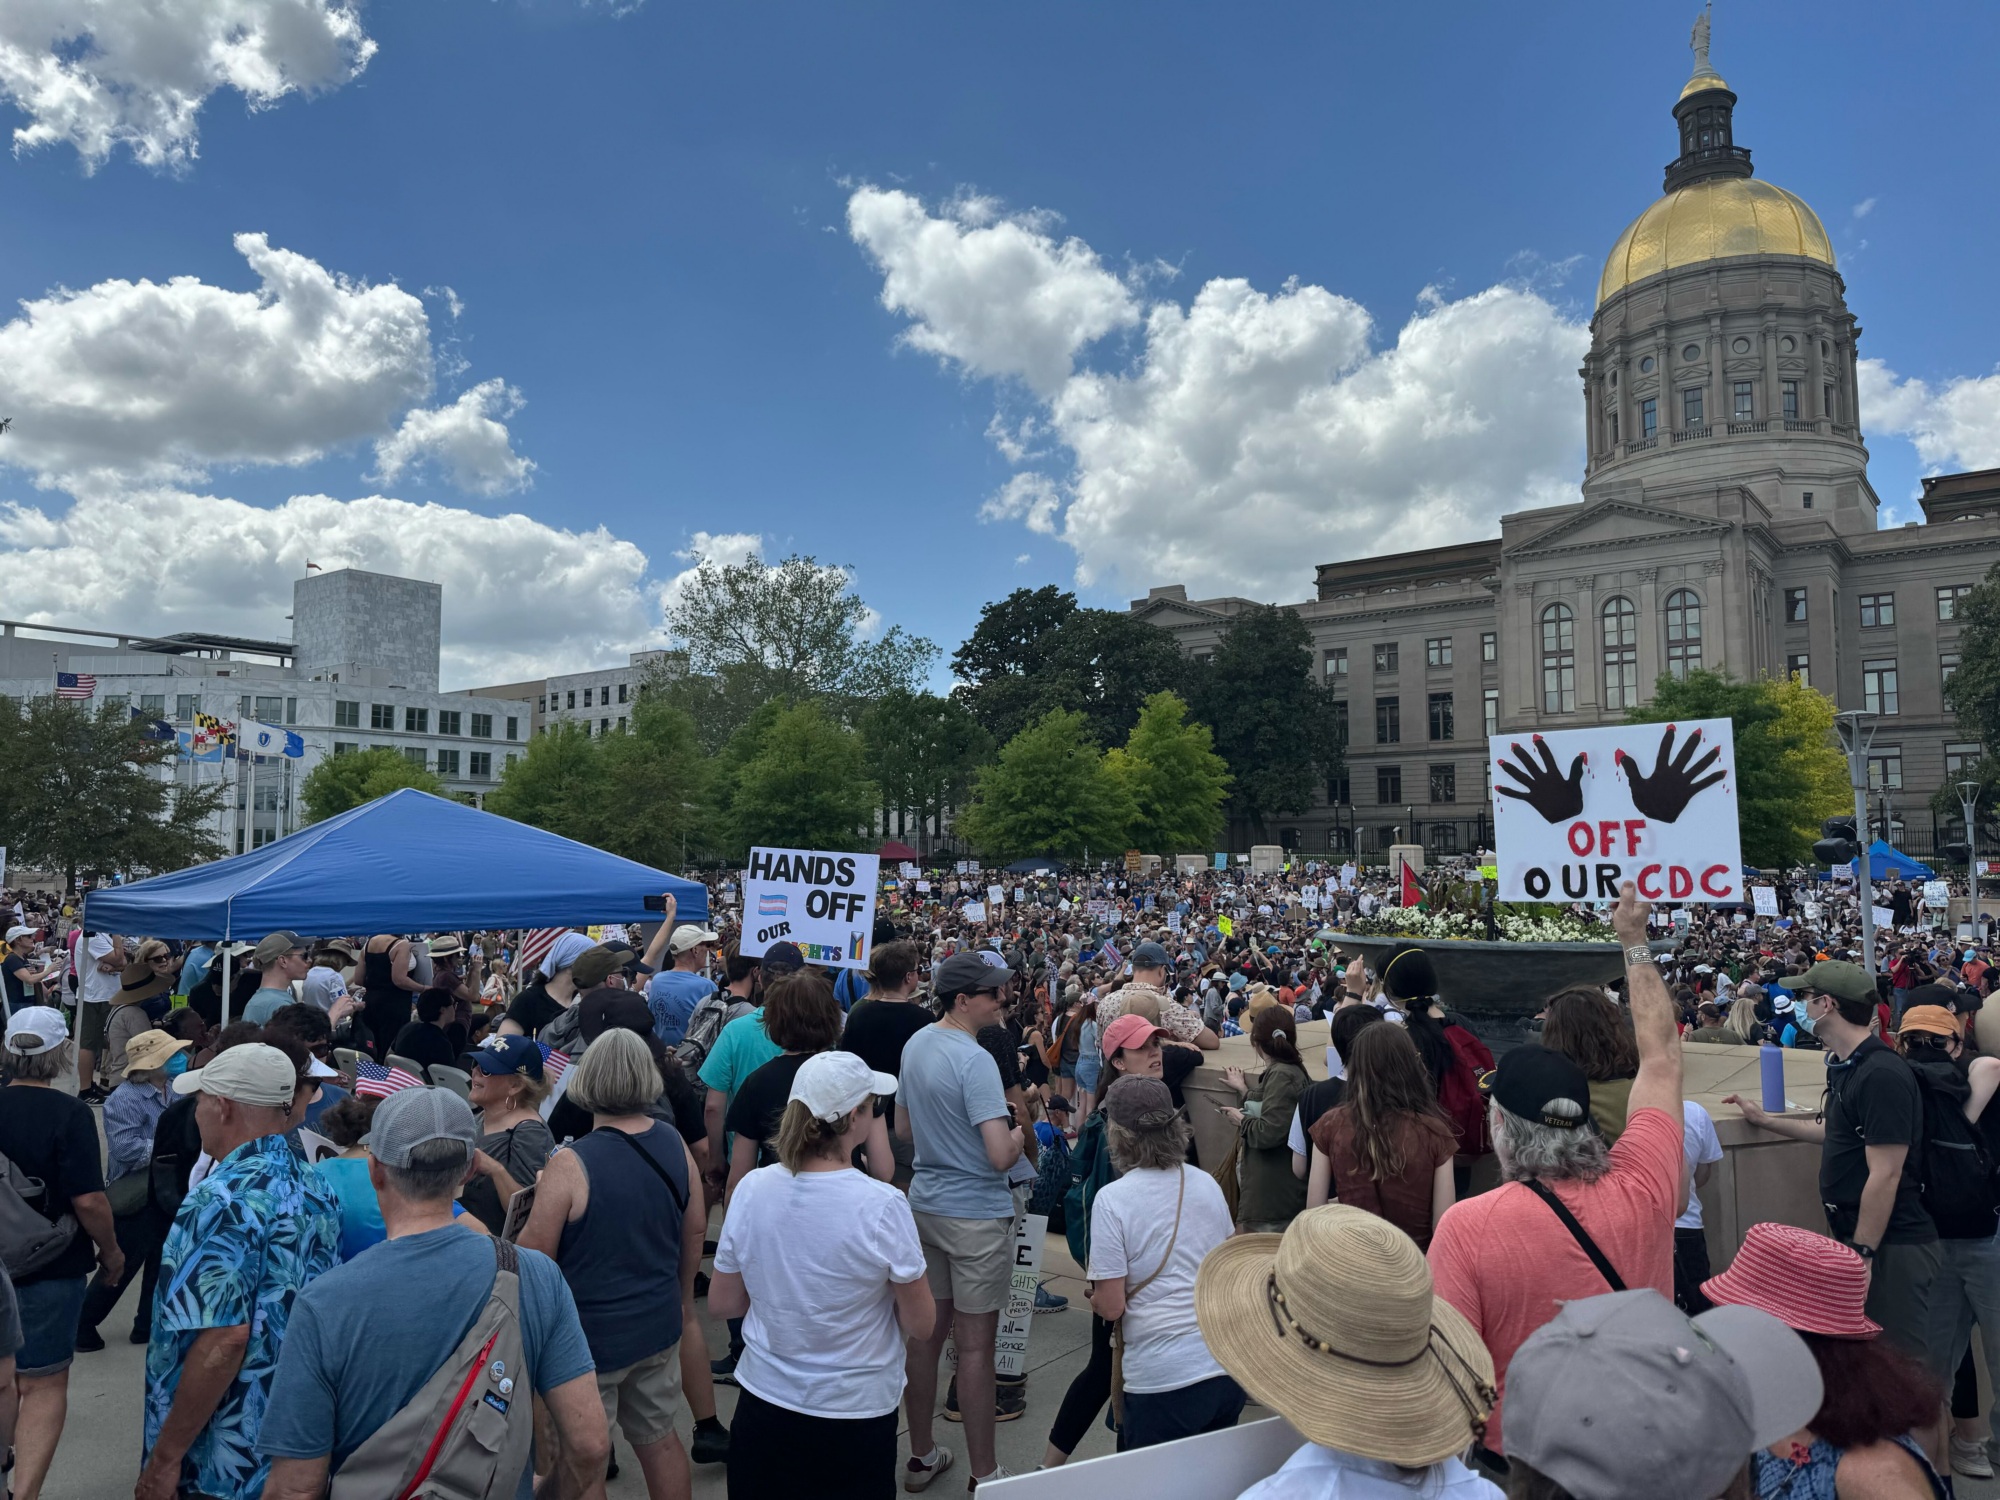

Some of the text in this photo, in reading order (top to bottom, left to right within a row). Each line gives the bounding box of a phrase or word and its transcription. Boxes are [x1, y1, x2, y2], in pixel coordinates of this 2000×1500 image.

[1567, 819, 1647, 857] OFF
[749, 851, 856, 887] HANDS
[1524, 864, 1732, 899] OUR CDC
[805, 889, 866, 923] OFF
[757, 921, 792, 943] OUR
[1544, 1116, 1573, 1127] VETERAN
[995, 1338, 1025, 1351] cience
[998, 1355, 1014, 1369] All
